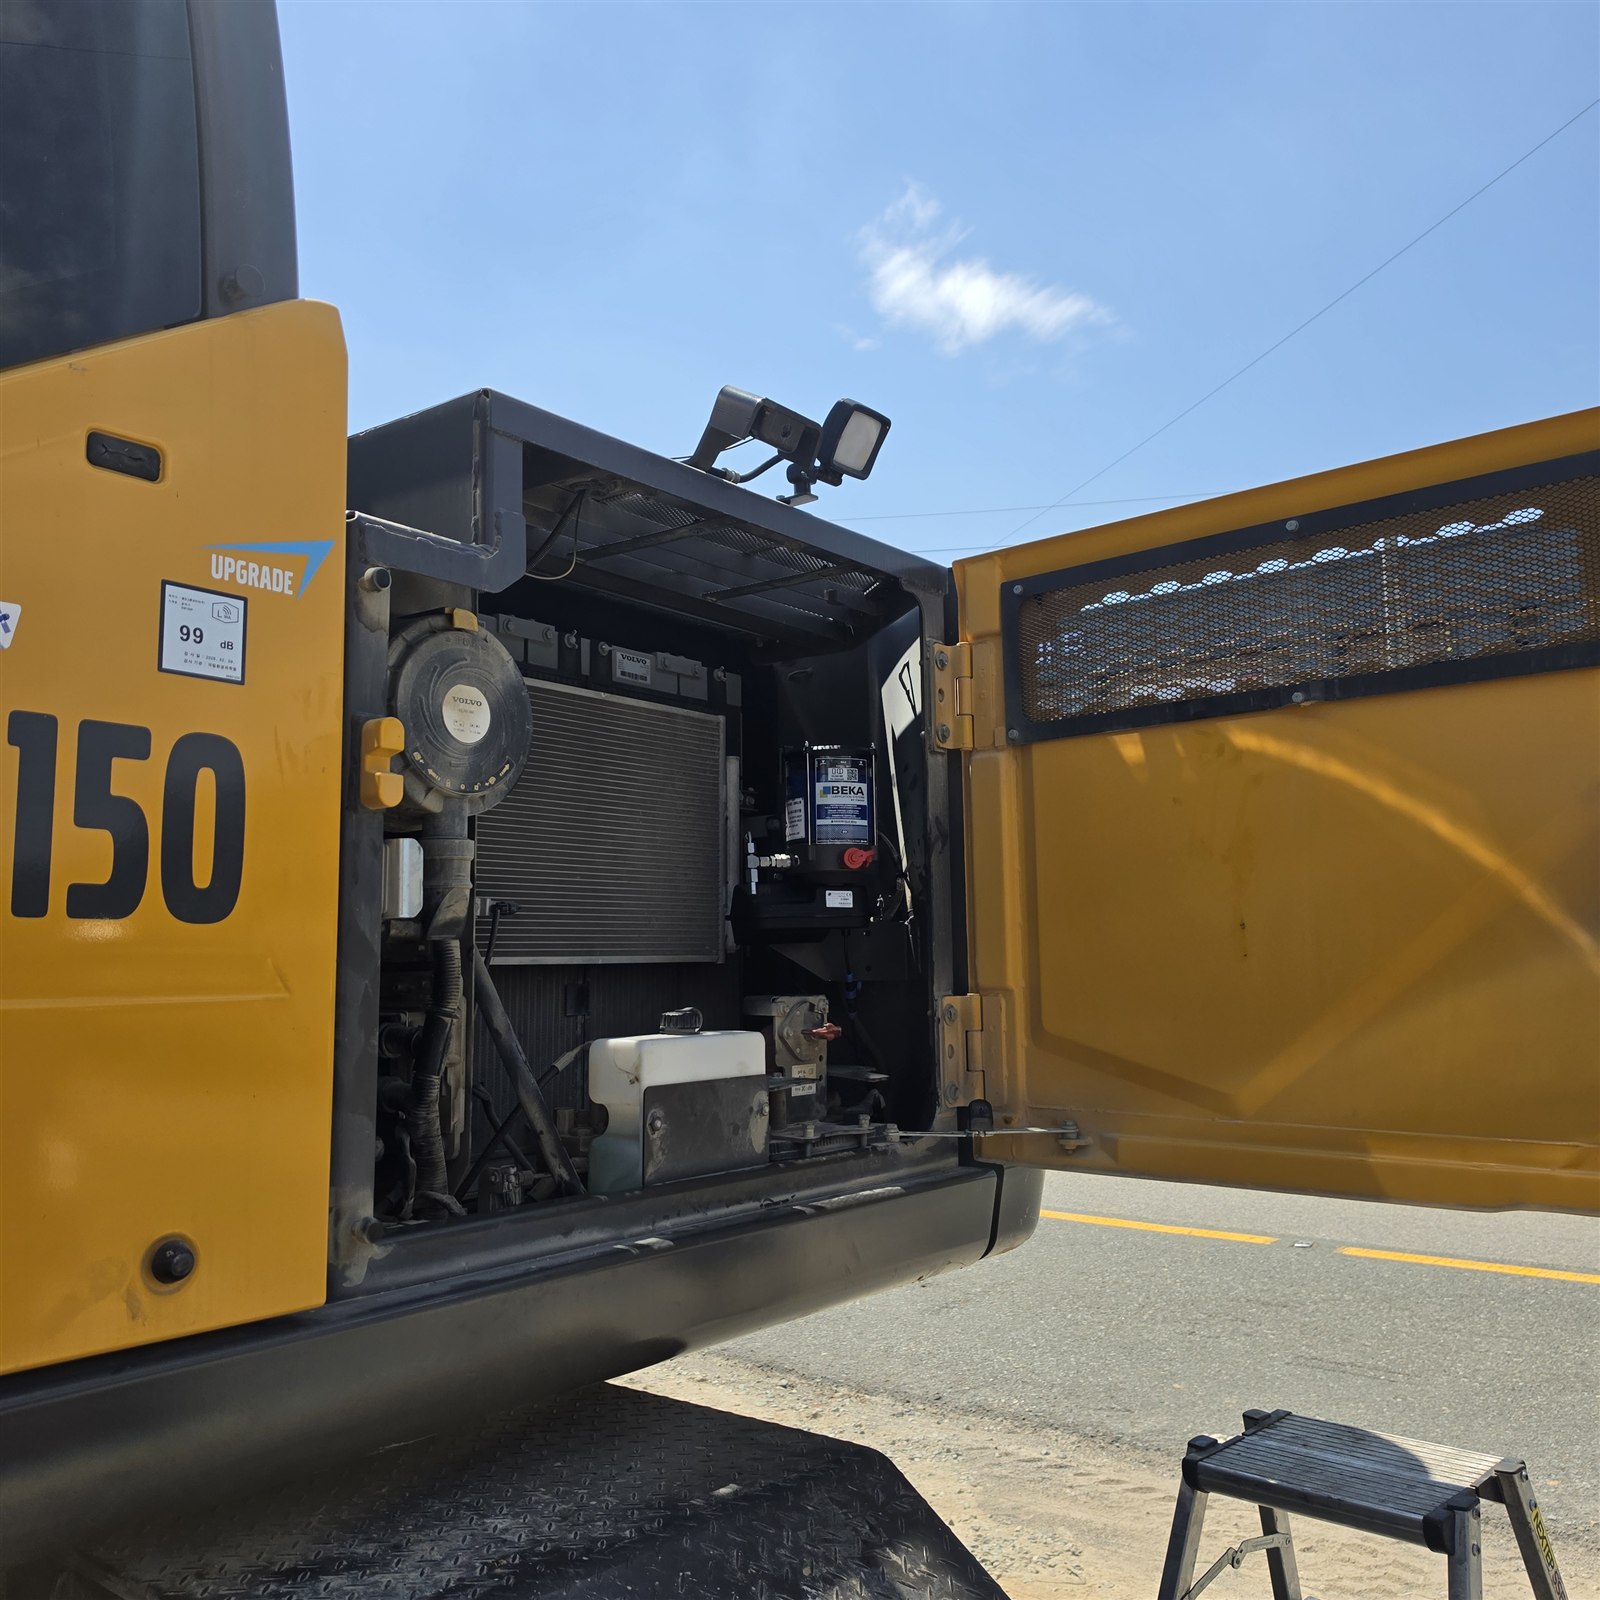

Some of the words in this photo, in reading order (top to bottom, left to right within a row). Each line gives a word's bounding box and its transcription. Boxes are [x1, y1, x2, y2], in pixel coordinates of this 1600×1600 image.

[211, 553, 294, 595] UPGRADE
[179, 624, 204, 644] 99
[220, 640, 234, 650] dB
[620, 653, 647, 665] VOLVO
[452, 696, 482, 707] VOLVO
[831, 785, 865, 796] BEKA
[7, 709, 246, 925] 150
